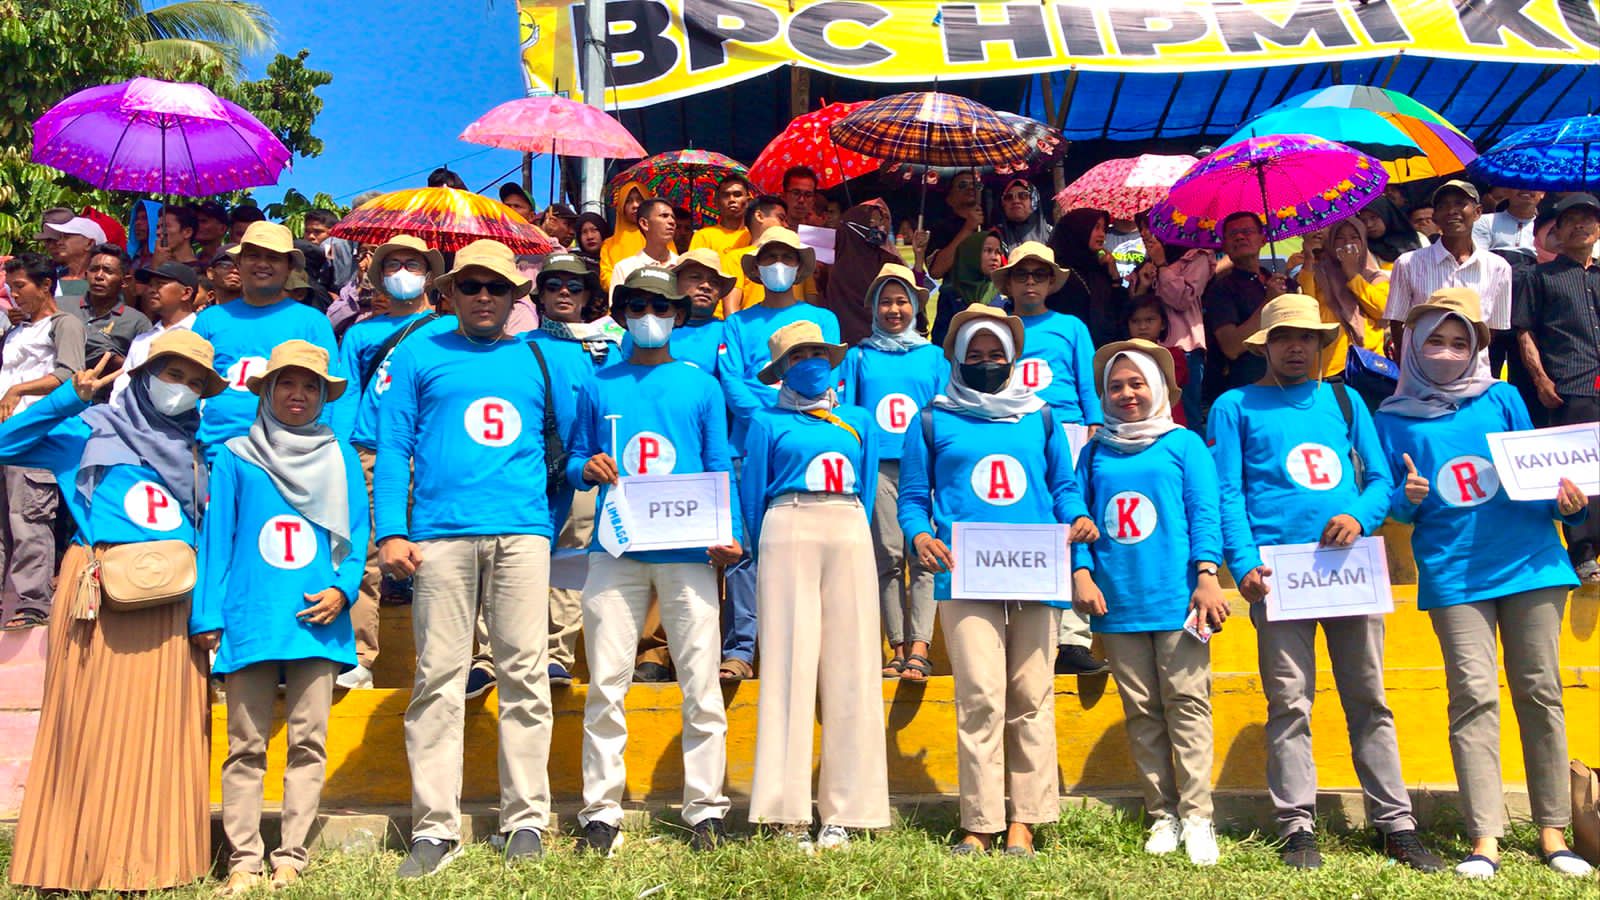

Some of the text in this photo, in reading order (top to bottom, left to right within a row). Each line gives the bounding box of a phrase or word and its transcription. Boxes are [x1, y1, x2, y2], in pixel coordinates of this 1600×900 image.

[571, 0, 892, 89] BPC
[941, 0, 1410, 63] HIPMI
[483, 402, 504, 441] S
[889, 398, 907, 429] G
[637, 436, 660, 475] P
[1301, 448, 1330, 485] E
[1513, 447, 1600, 470] KAYUAH
[822, 458, 844, 493] N
[987, 460, 1015, 499] A
[1450, 461, 1487, 503] R
[144, 484, 169, 524] P
[604, 500, 630, 545] LIMBAGO
[649, 499, 699, 519] PTSP
[1116, 497, 1141, 538] K
[275, 521, 301, 562] T
[975, 549, 1048, 569] NAKER
[1286, 566, 1367, 590] SALAM
